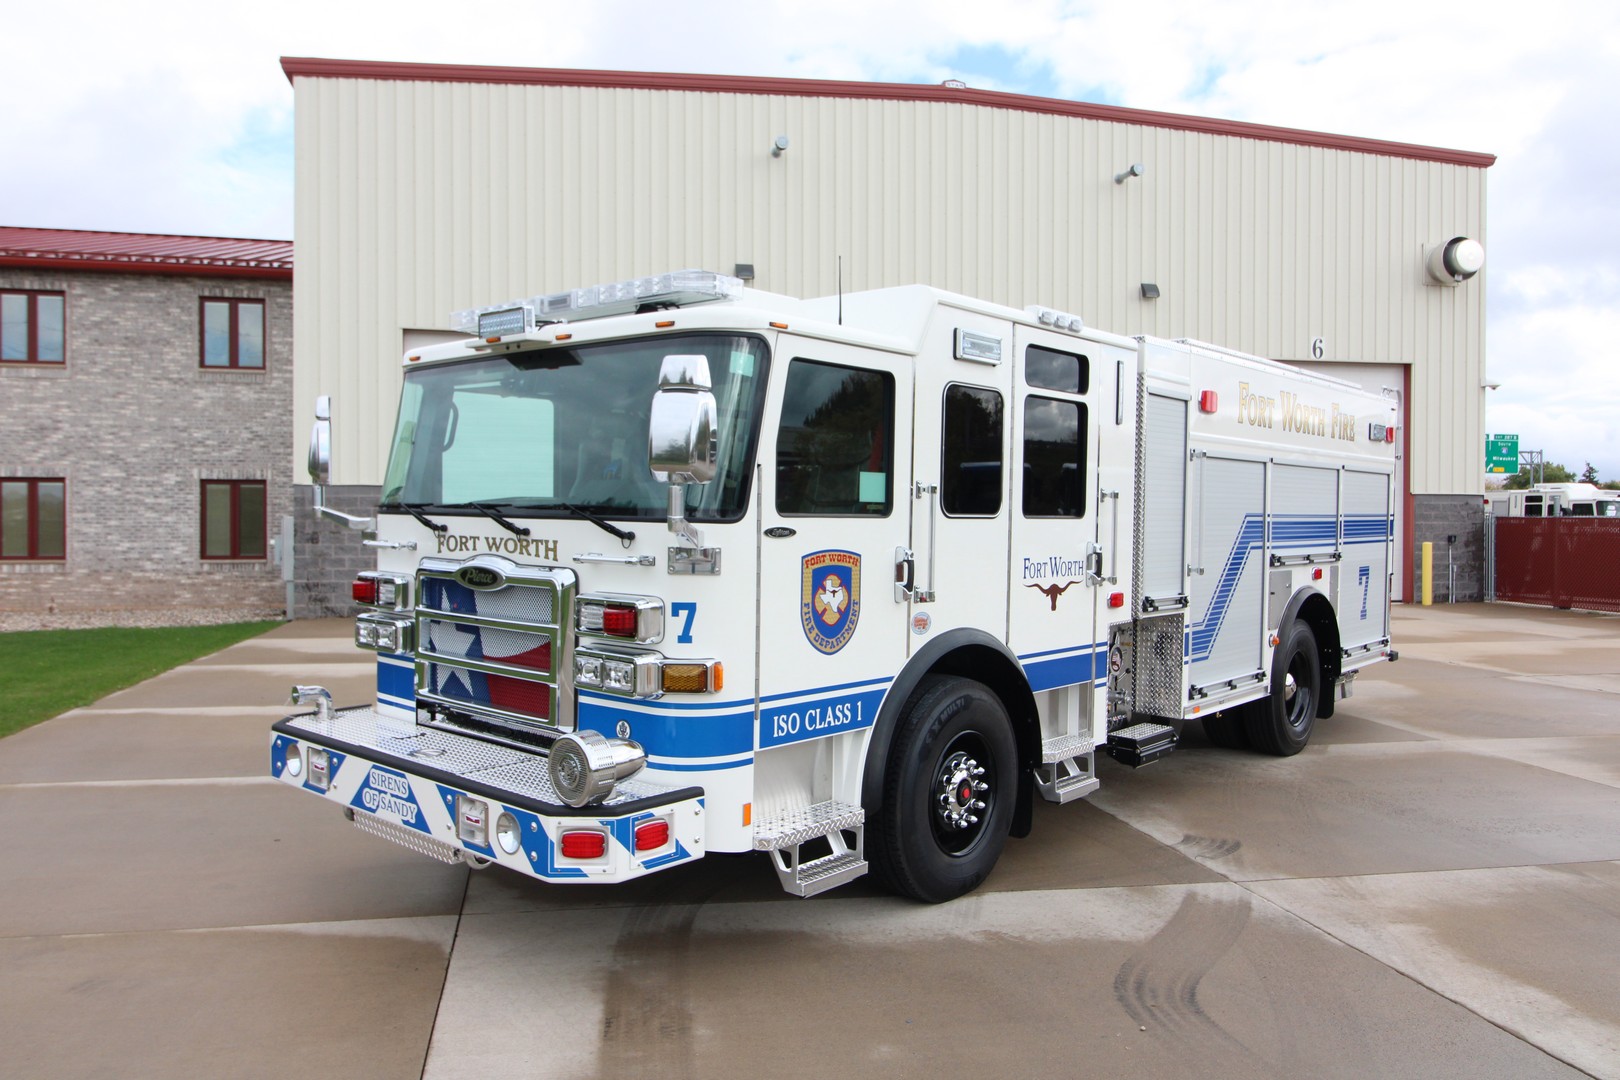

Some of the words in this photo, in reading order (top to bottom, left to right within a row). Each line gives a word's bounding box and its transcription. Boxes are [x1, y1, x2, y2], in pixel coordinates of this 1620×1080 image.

[1312, 338, 1323, 359] 6
[1237, 381, 1275, 429] FORT
[1279, 390, 1326, 437] WORTH
[1331, 402, 1355, 442] FIRE
[437, 534, 480, 554] FORT
[484, 536, 559, 562] WORTH
[804, 554, 827, 569] FORT
[828, 553, 860, 567] WORTH
[1023, 557, 1048, 579] FORT
[1049, 556, 1084, 577] WORTH
[1359, 565, 1370, 620] 7
[671, 602, 697, 644] 7
[803, 602, 815, 634] FIRE
[813, 600, 859, 650] DEPARTMENT
[772, 712, 800, 738] ISO
[805, 703, 851, 731] CLASS
[857, 700, 862, 721] 1
[940, 697, 965, 722] MULTI
[371, 771, 408, 795] SIRENS
[364, 790, 378, 806] OF
[380, 796, 416, 820] SANDY
